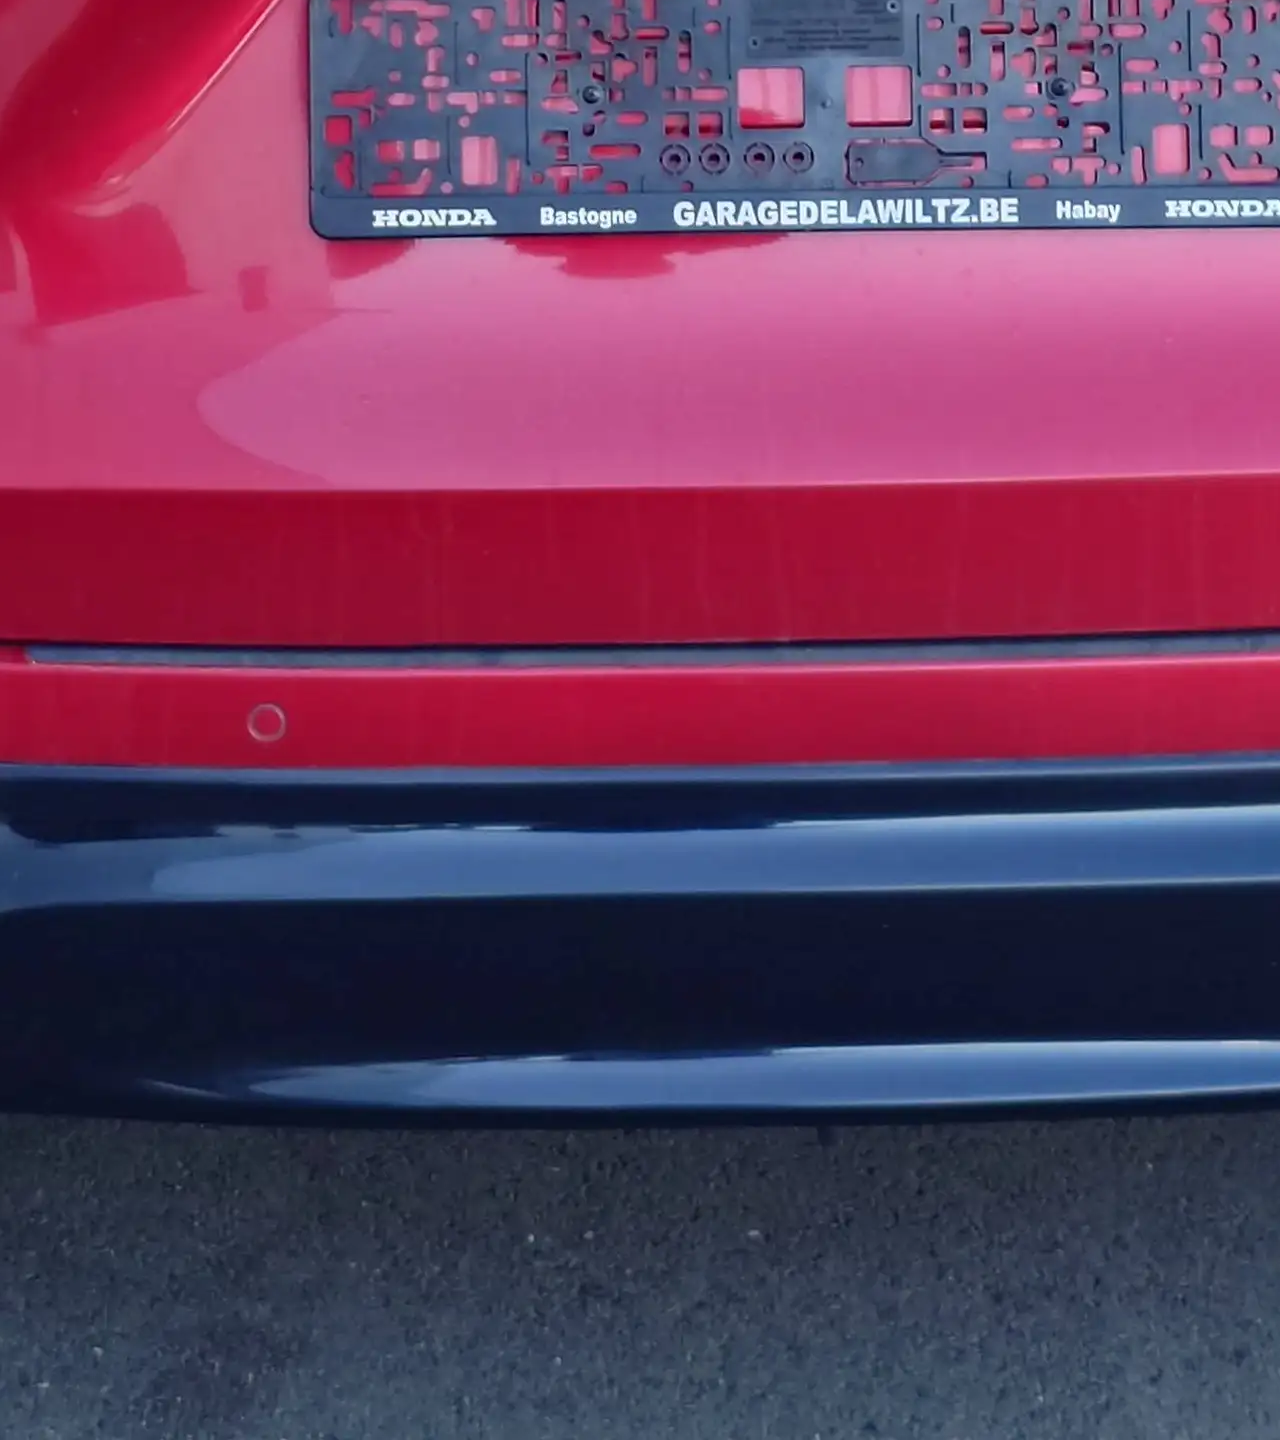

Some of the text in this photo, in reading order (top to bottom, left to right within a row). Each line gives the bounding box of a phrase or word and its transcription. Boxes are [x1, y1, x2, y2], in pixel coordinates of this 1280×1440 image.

[372, 208, 497, 227] HONDA
[539, 207, 637, 227] Bastogne
[672, 196, 1019, 227] GARAGEDELAWILTZ.BE
[1055, 198, 1121, 223] Habay
